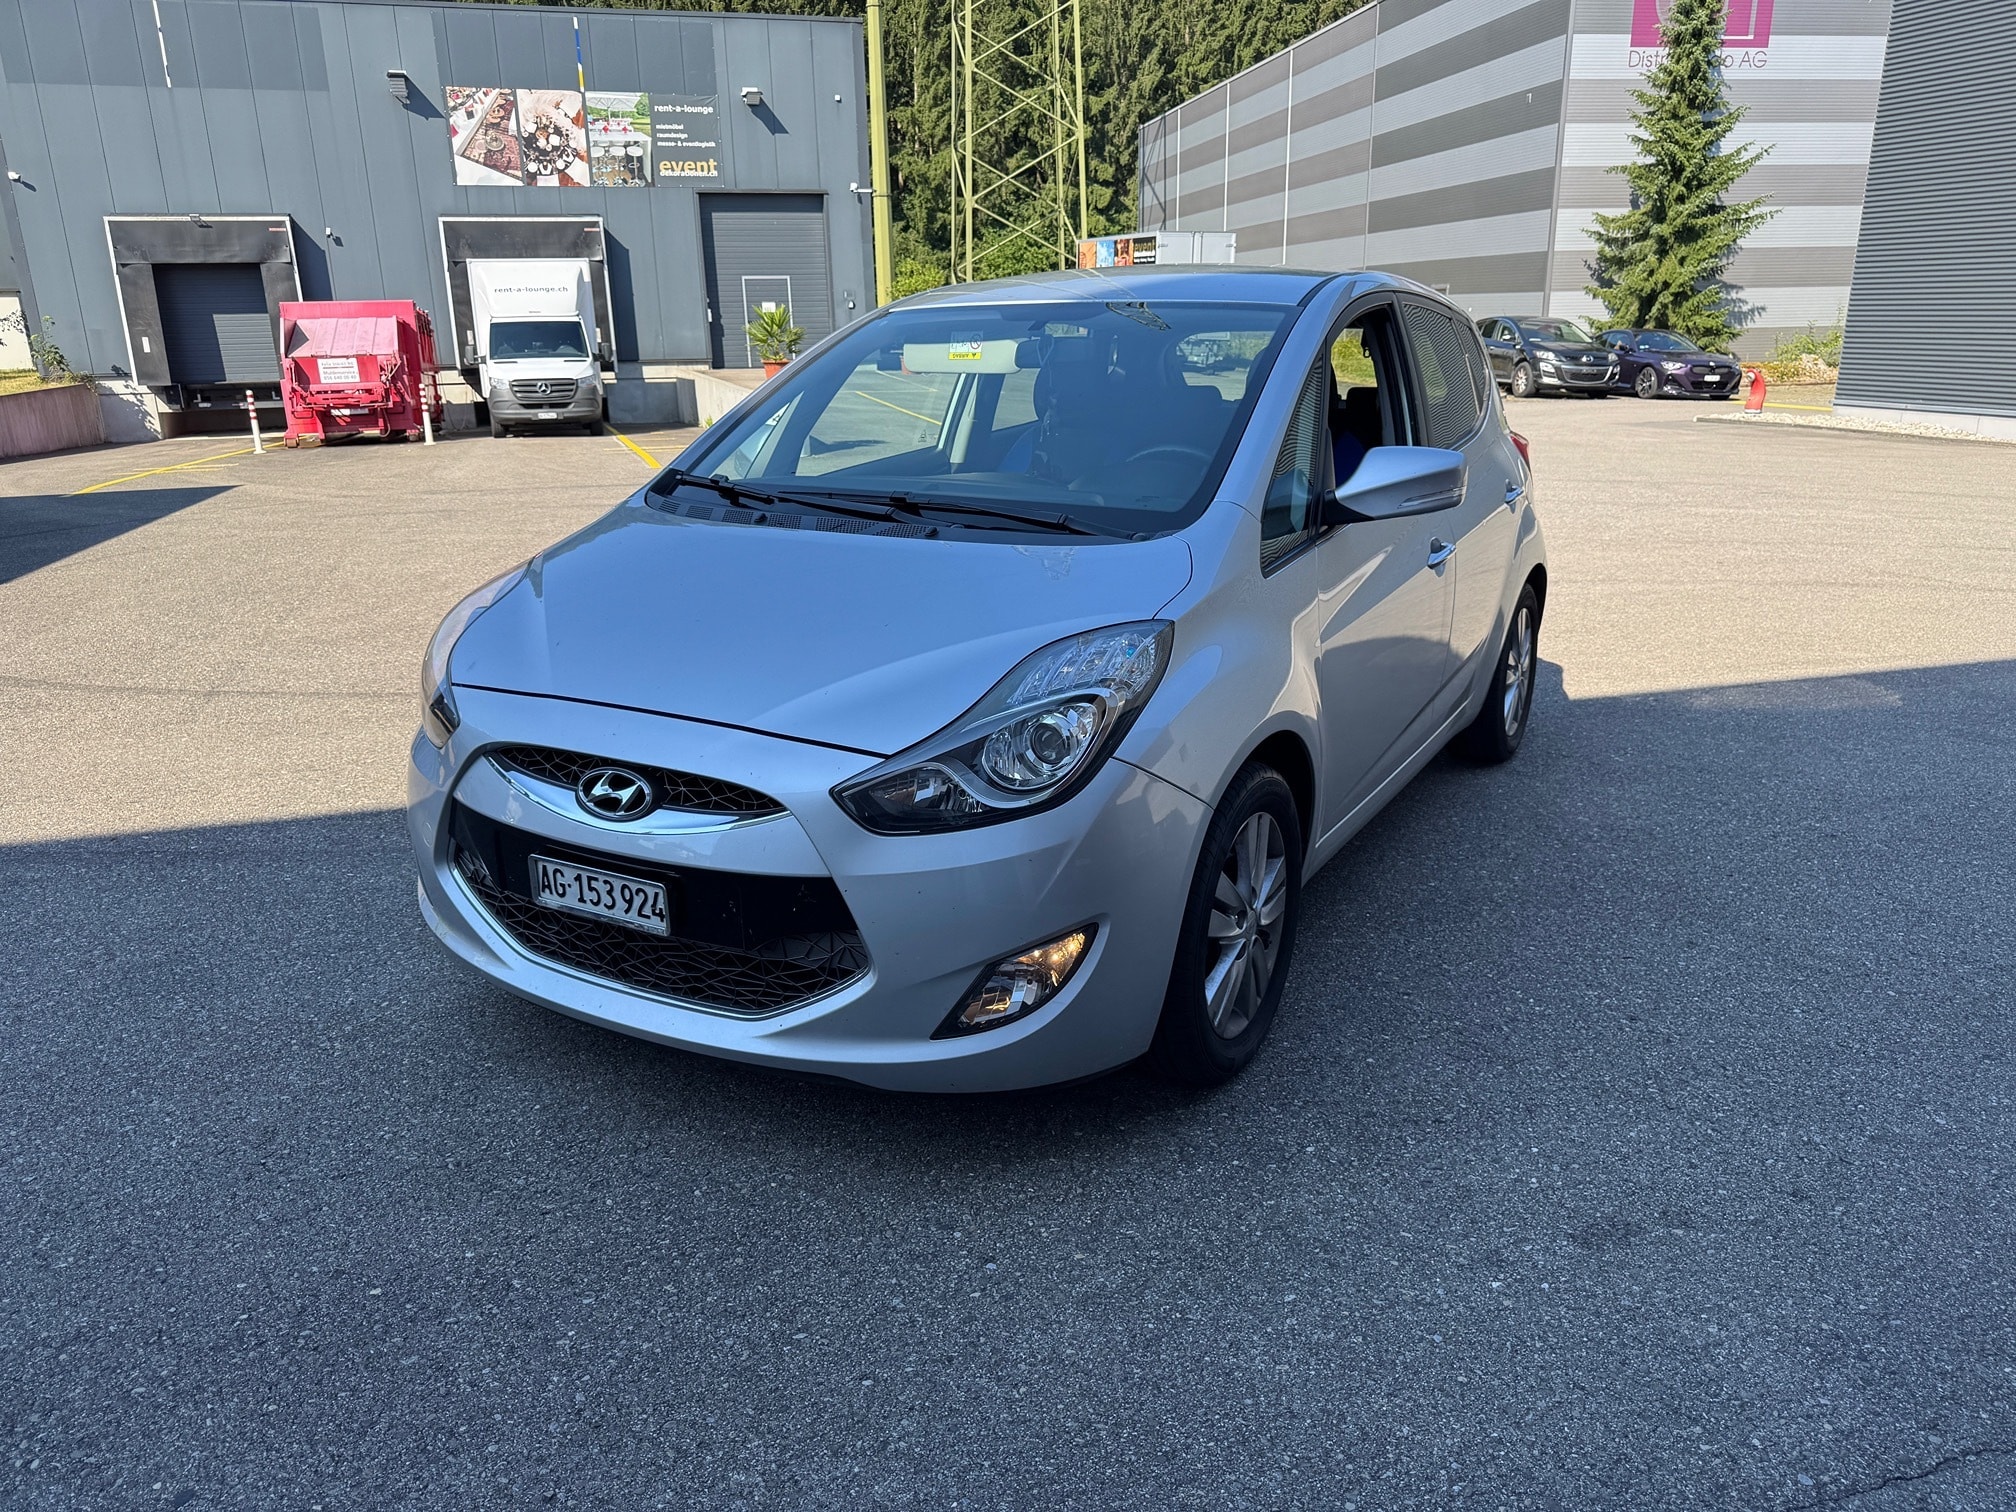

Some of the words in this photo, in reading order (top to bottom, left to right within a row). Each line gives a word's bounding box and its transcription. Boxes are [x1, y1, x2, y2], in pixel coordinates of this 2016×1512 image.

[1738, 50, 1768, 68] AG
[654, 104, 714, 114] rent-a-lounge
[659, 158, 718, 174] event
